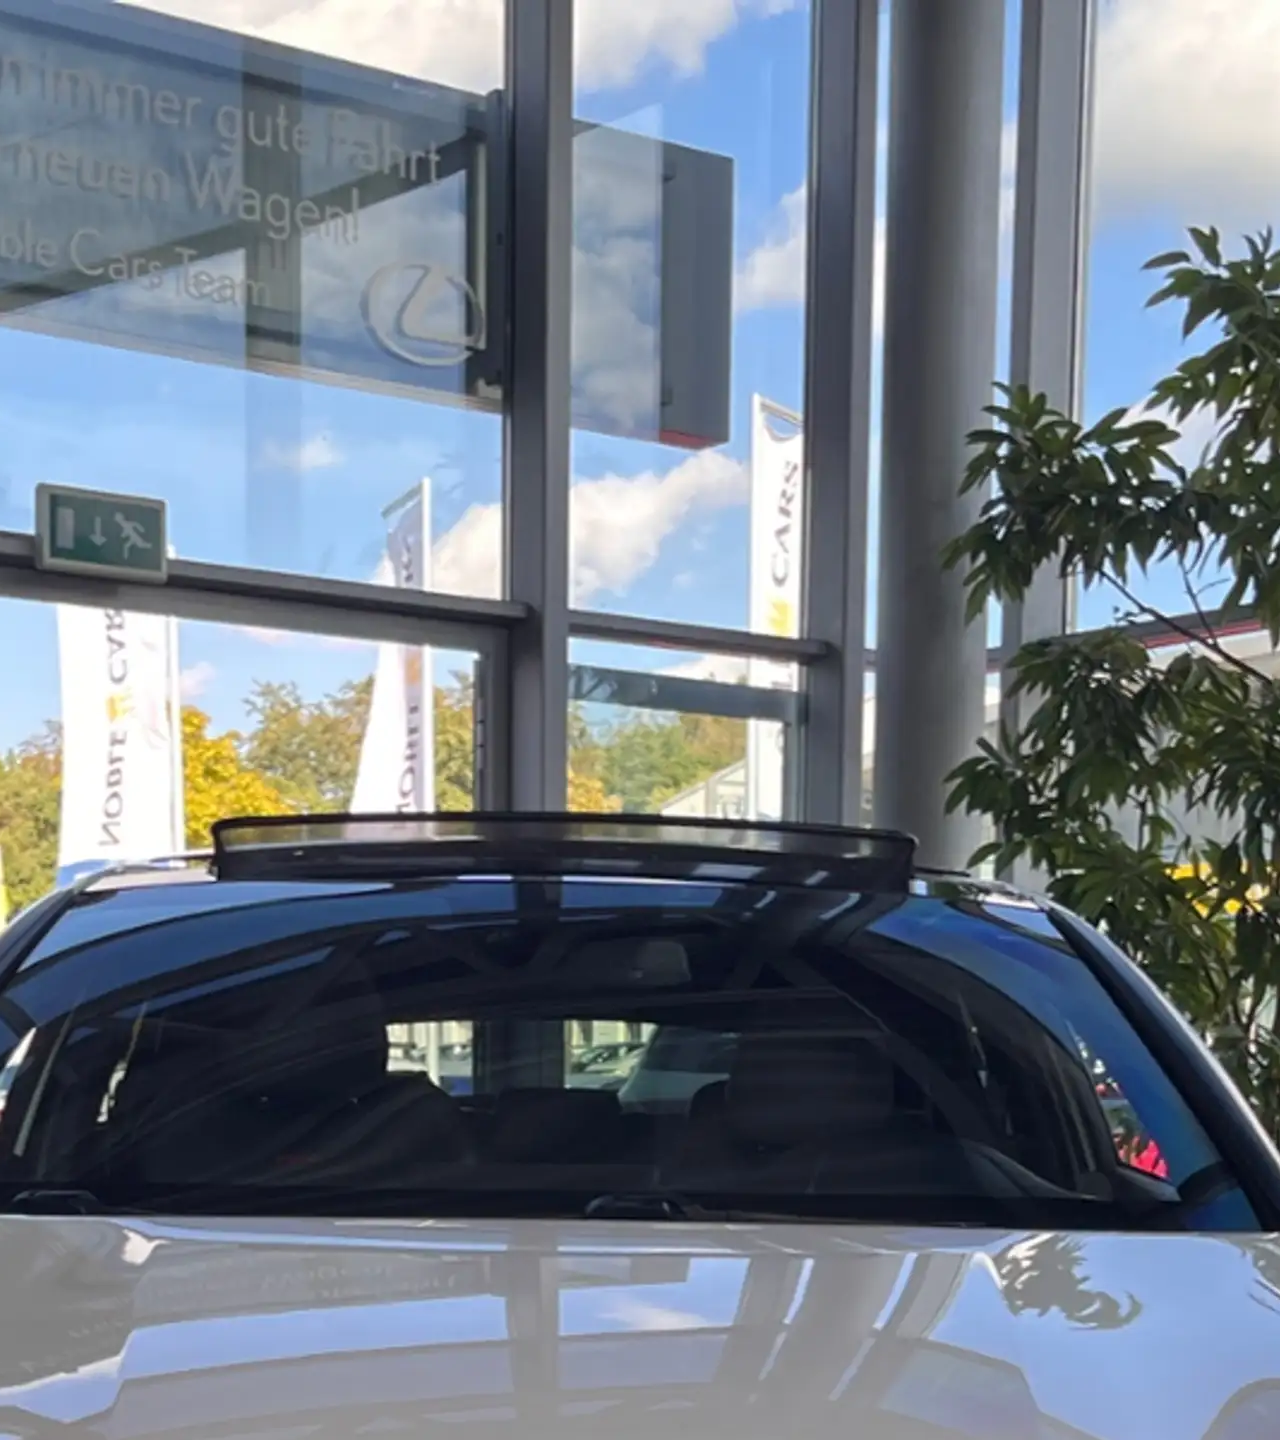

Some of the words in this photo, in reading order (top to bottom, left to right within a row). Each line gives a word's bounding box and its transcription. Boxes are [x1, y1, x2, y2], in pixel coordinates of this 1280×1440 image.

[42, 45, 203, 131] immer
[216, 102, 312, 158] gute
[326, 107, 441, 183] Fahrt
[184, 151, 360, 245] Wagen!
[70, 227, 162, 292] Cars
[173, 245, 270, 308] Team
